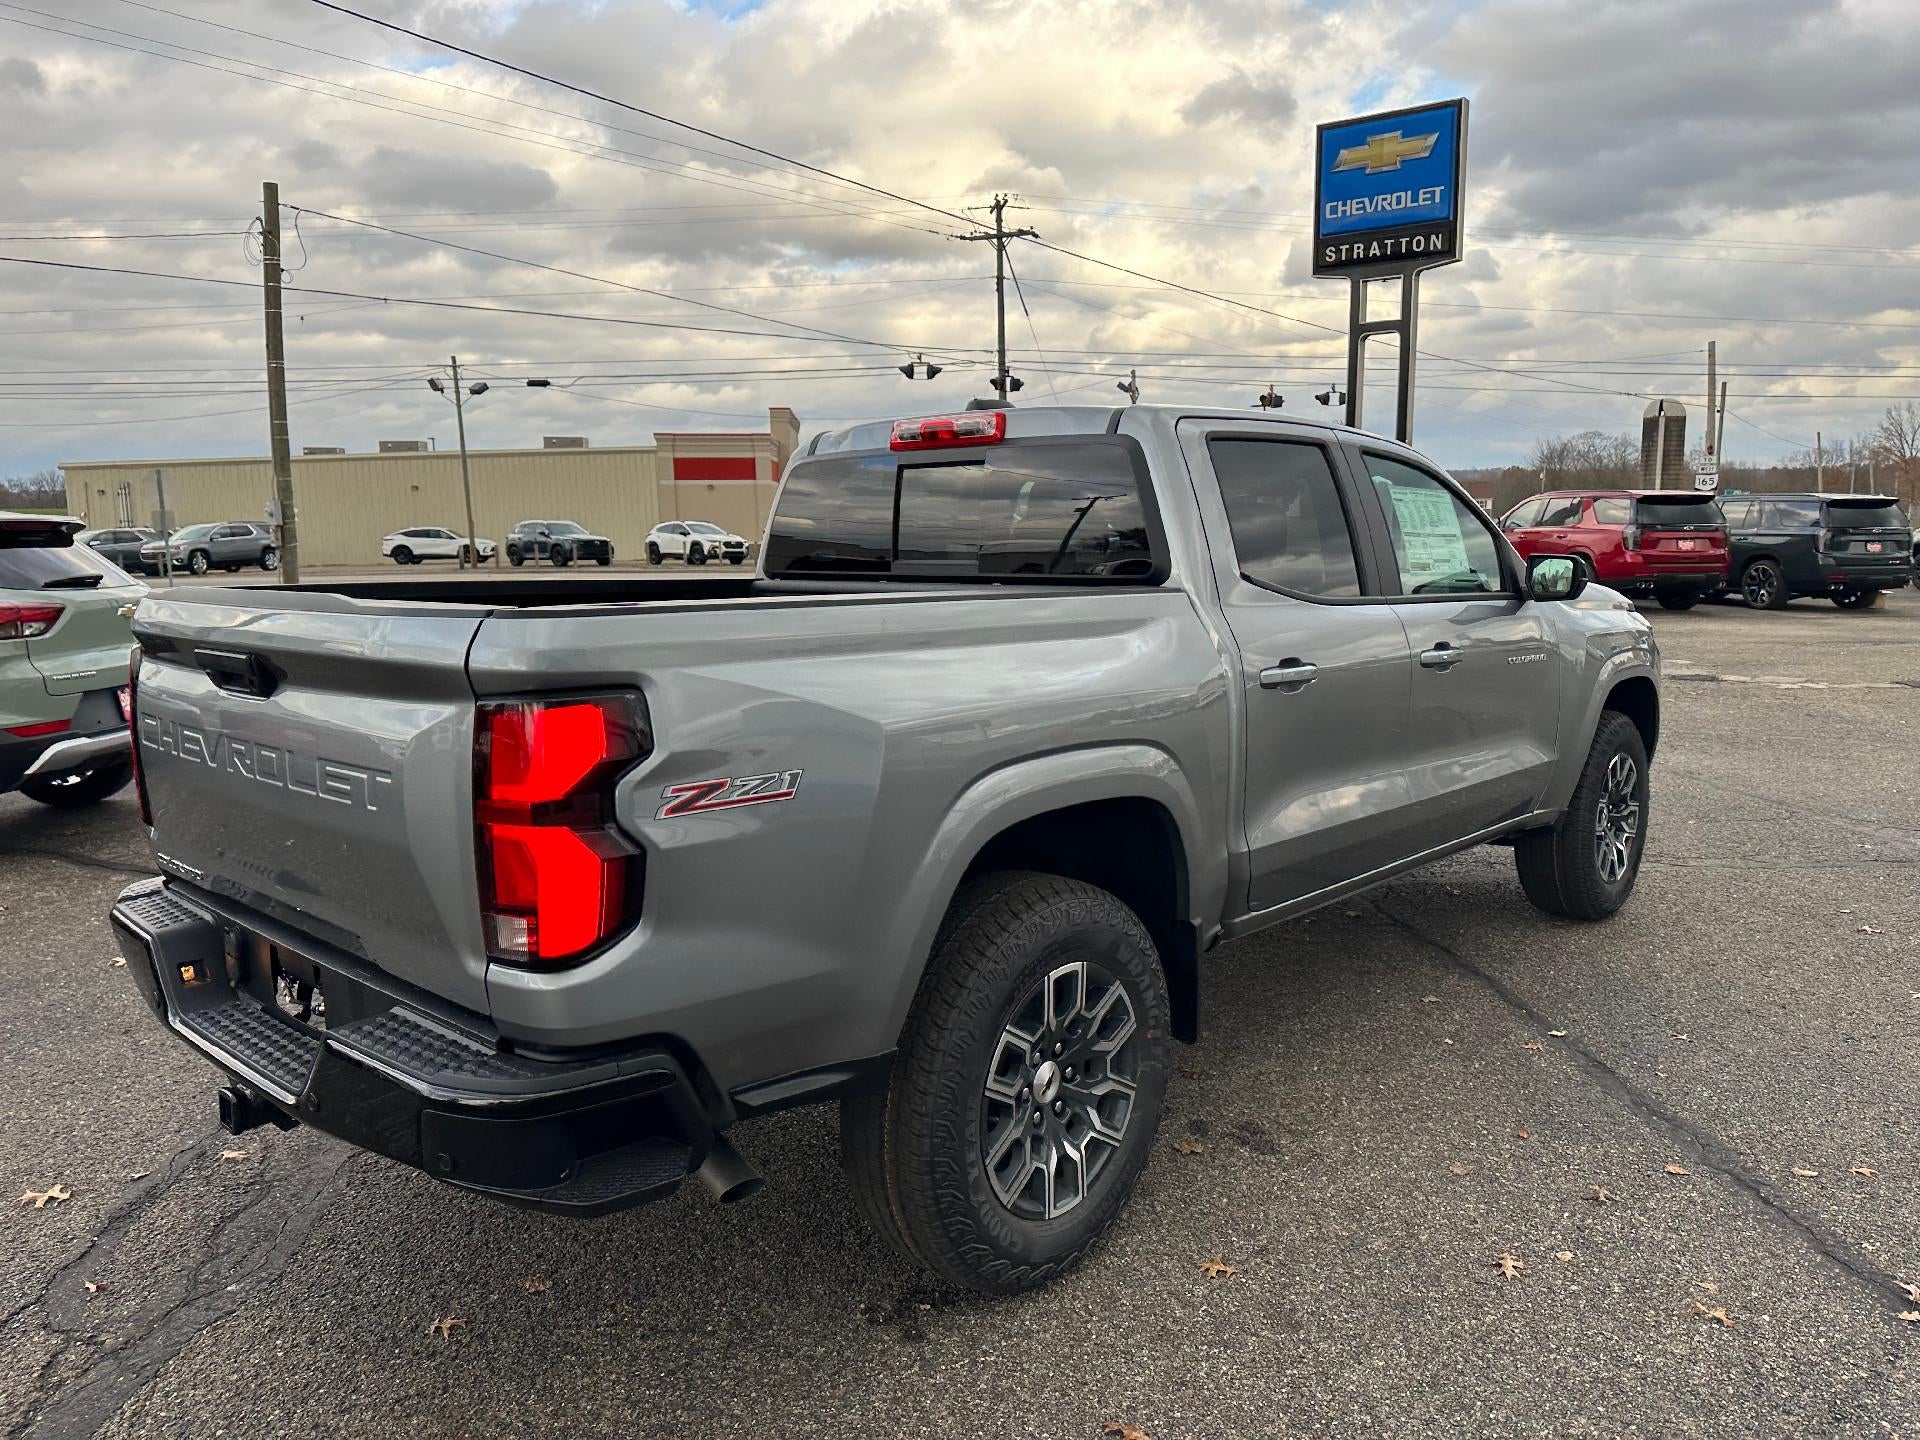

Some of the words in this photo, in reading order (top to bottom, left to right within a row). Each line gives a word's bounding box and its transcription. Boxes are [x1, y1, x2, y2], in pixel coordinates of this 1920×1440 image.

[1325, 186, 1445, 219] CHEVROLET
[1325, 233, 1443, 262] STRATTON
[1697, 477, 1715, 487] 165
[140, 711, 392, 811] CHEVROLET
[653, 768, 805, 821] Z71
